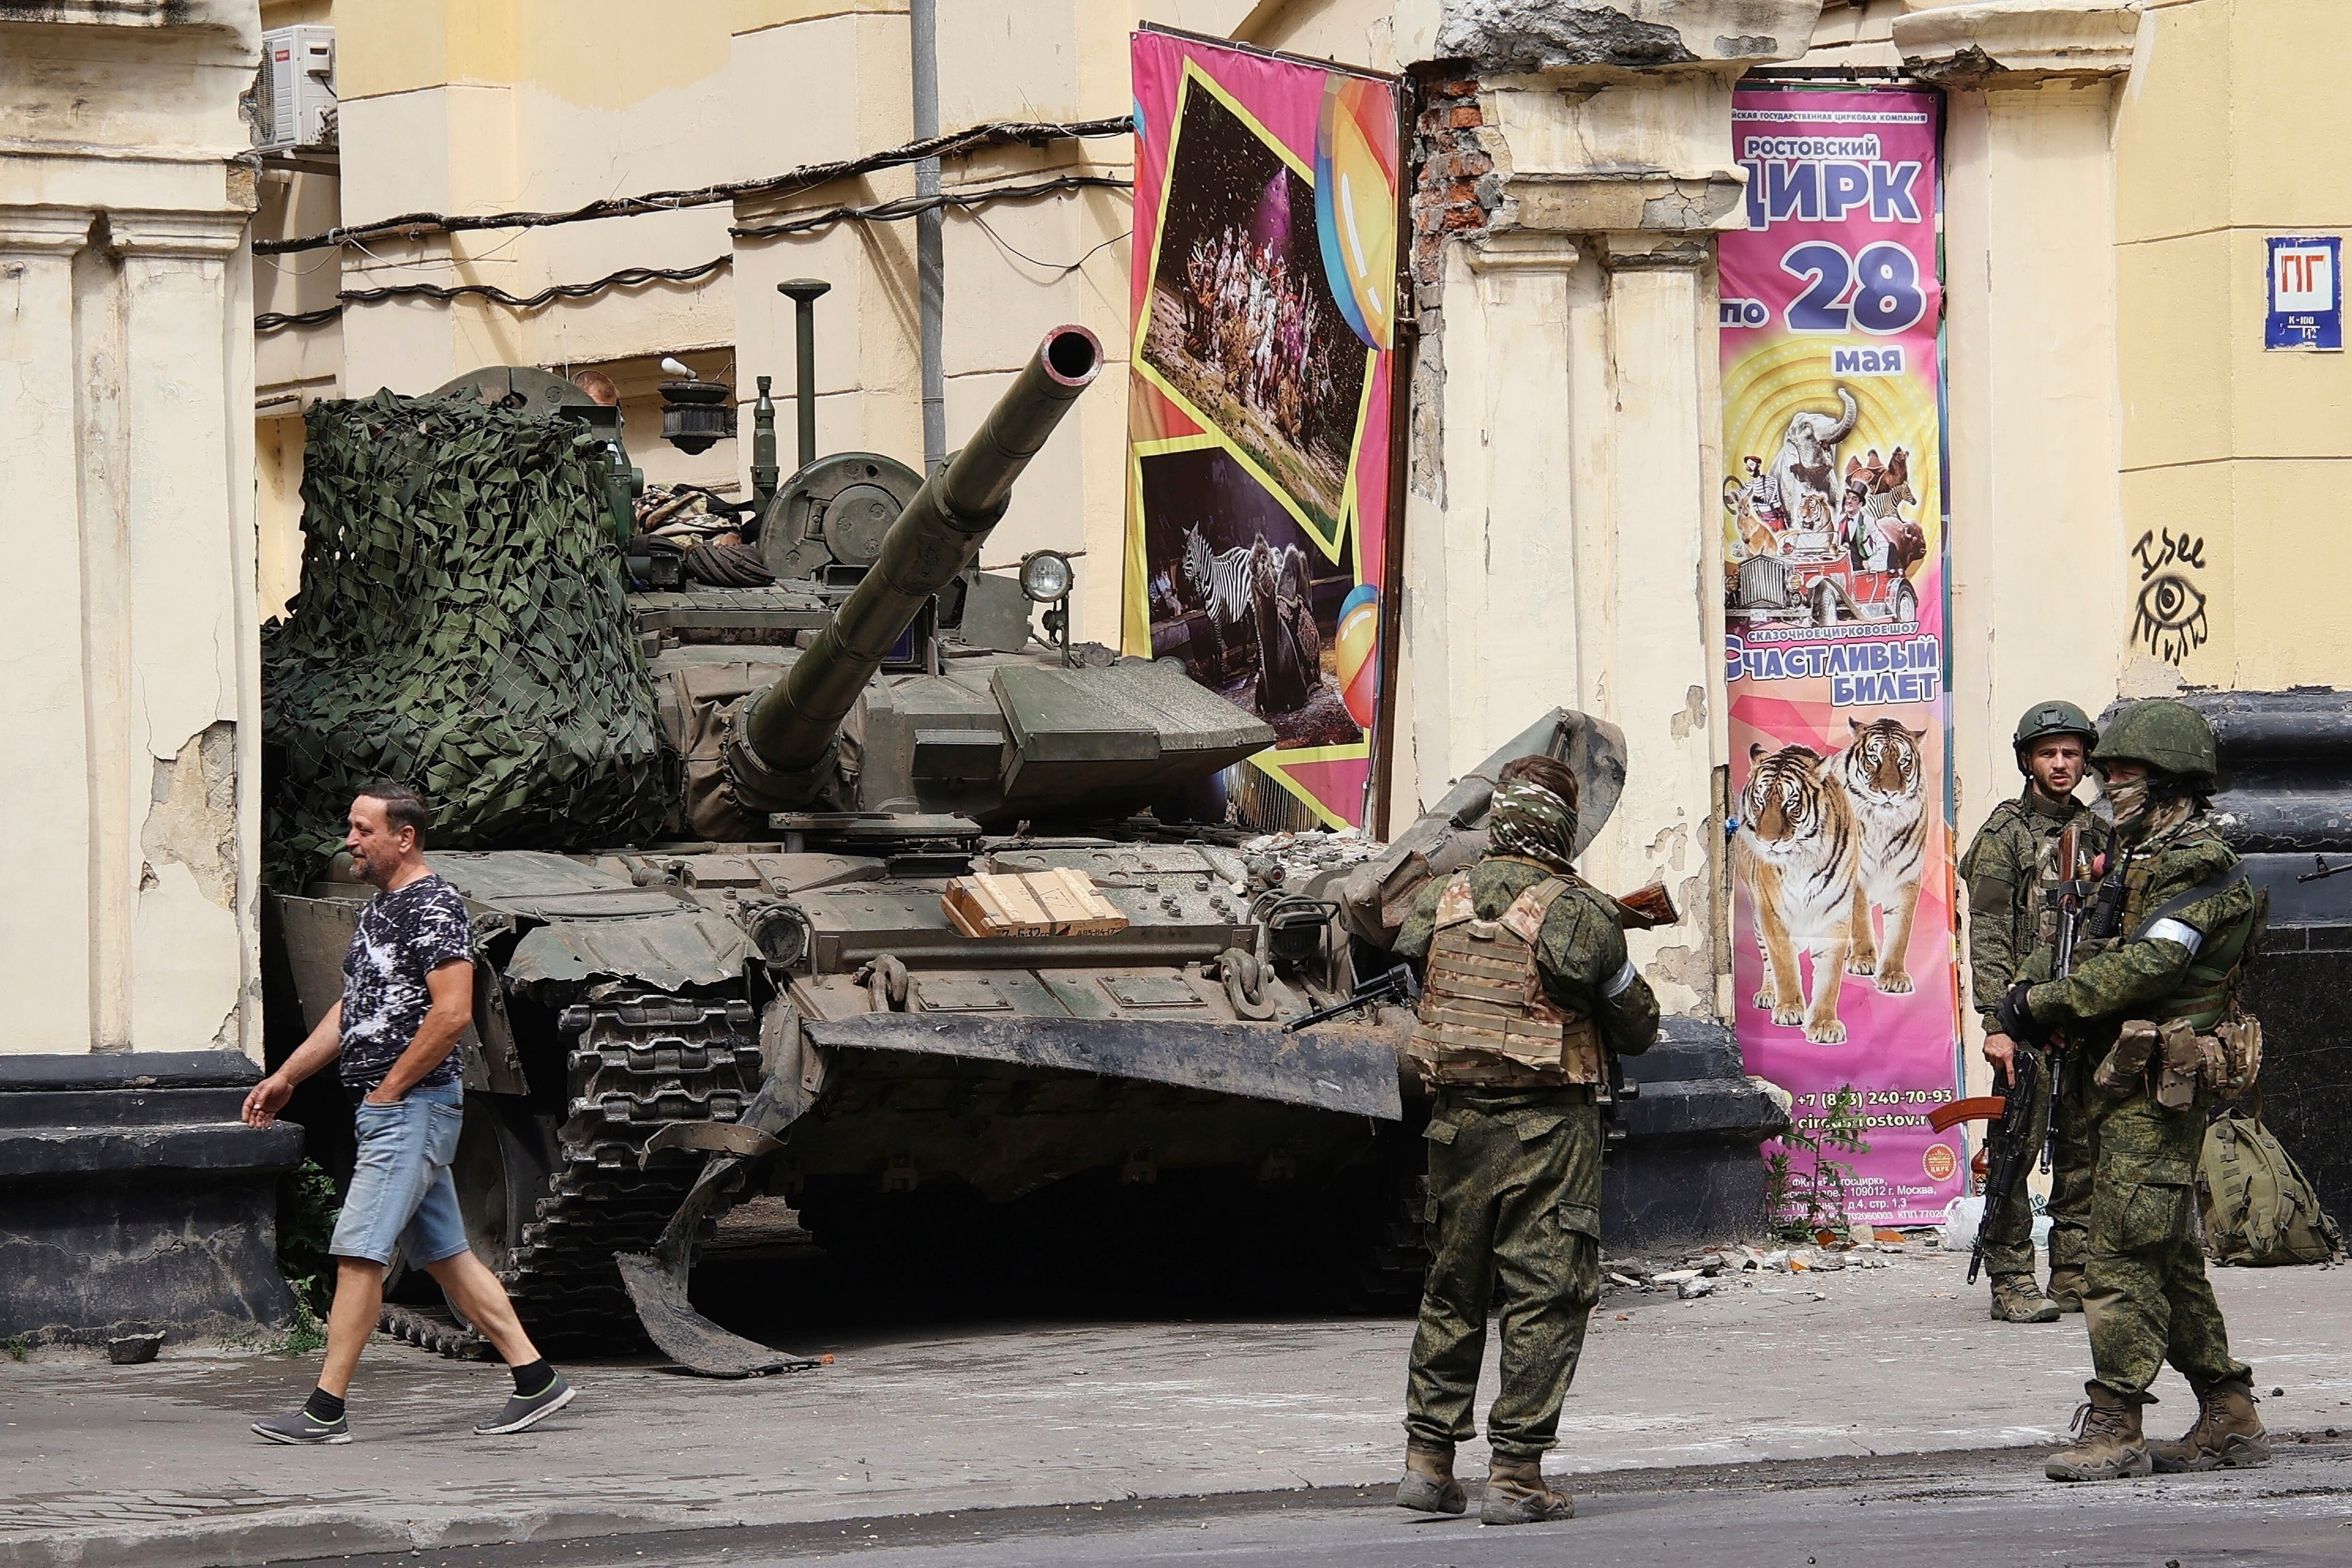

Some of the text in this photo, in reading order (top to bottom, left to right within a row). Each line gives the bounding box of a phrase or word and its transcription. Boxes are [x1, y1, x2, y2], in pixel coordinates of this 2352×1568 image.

[1760, 112, 1832, 120] ГОСУДАРСТВЕННАЯ
[1748, 138, 1877, 156] РОСТОВСКИЙ
[2281, 255, 2324, 293] ПГ
[1720, 246, 1920, 330] по 28
[1836, 350, 1901, 372] мая
[1748, 623, 1918, 641] СКАЗОЧНОЕ ЦИРКОВОЕ ШОУ
[1835, 673, 1937, 703] БИЛЕТ
[1798, 1089, 1952, 1109] +7 (83) 240-70-93
[1851, 1186, 1886, 1197] 109012
[1897, 1186, 1937, 1195] Москва,
[1848, 1199, 1867, 1210] д.4,
[1869, 1200, 1889, 1210] стр.
[1892, 1198, 1907, 1208] 1,3
[1898, 1210, 1917, 1219] КПП
